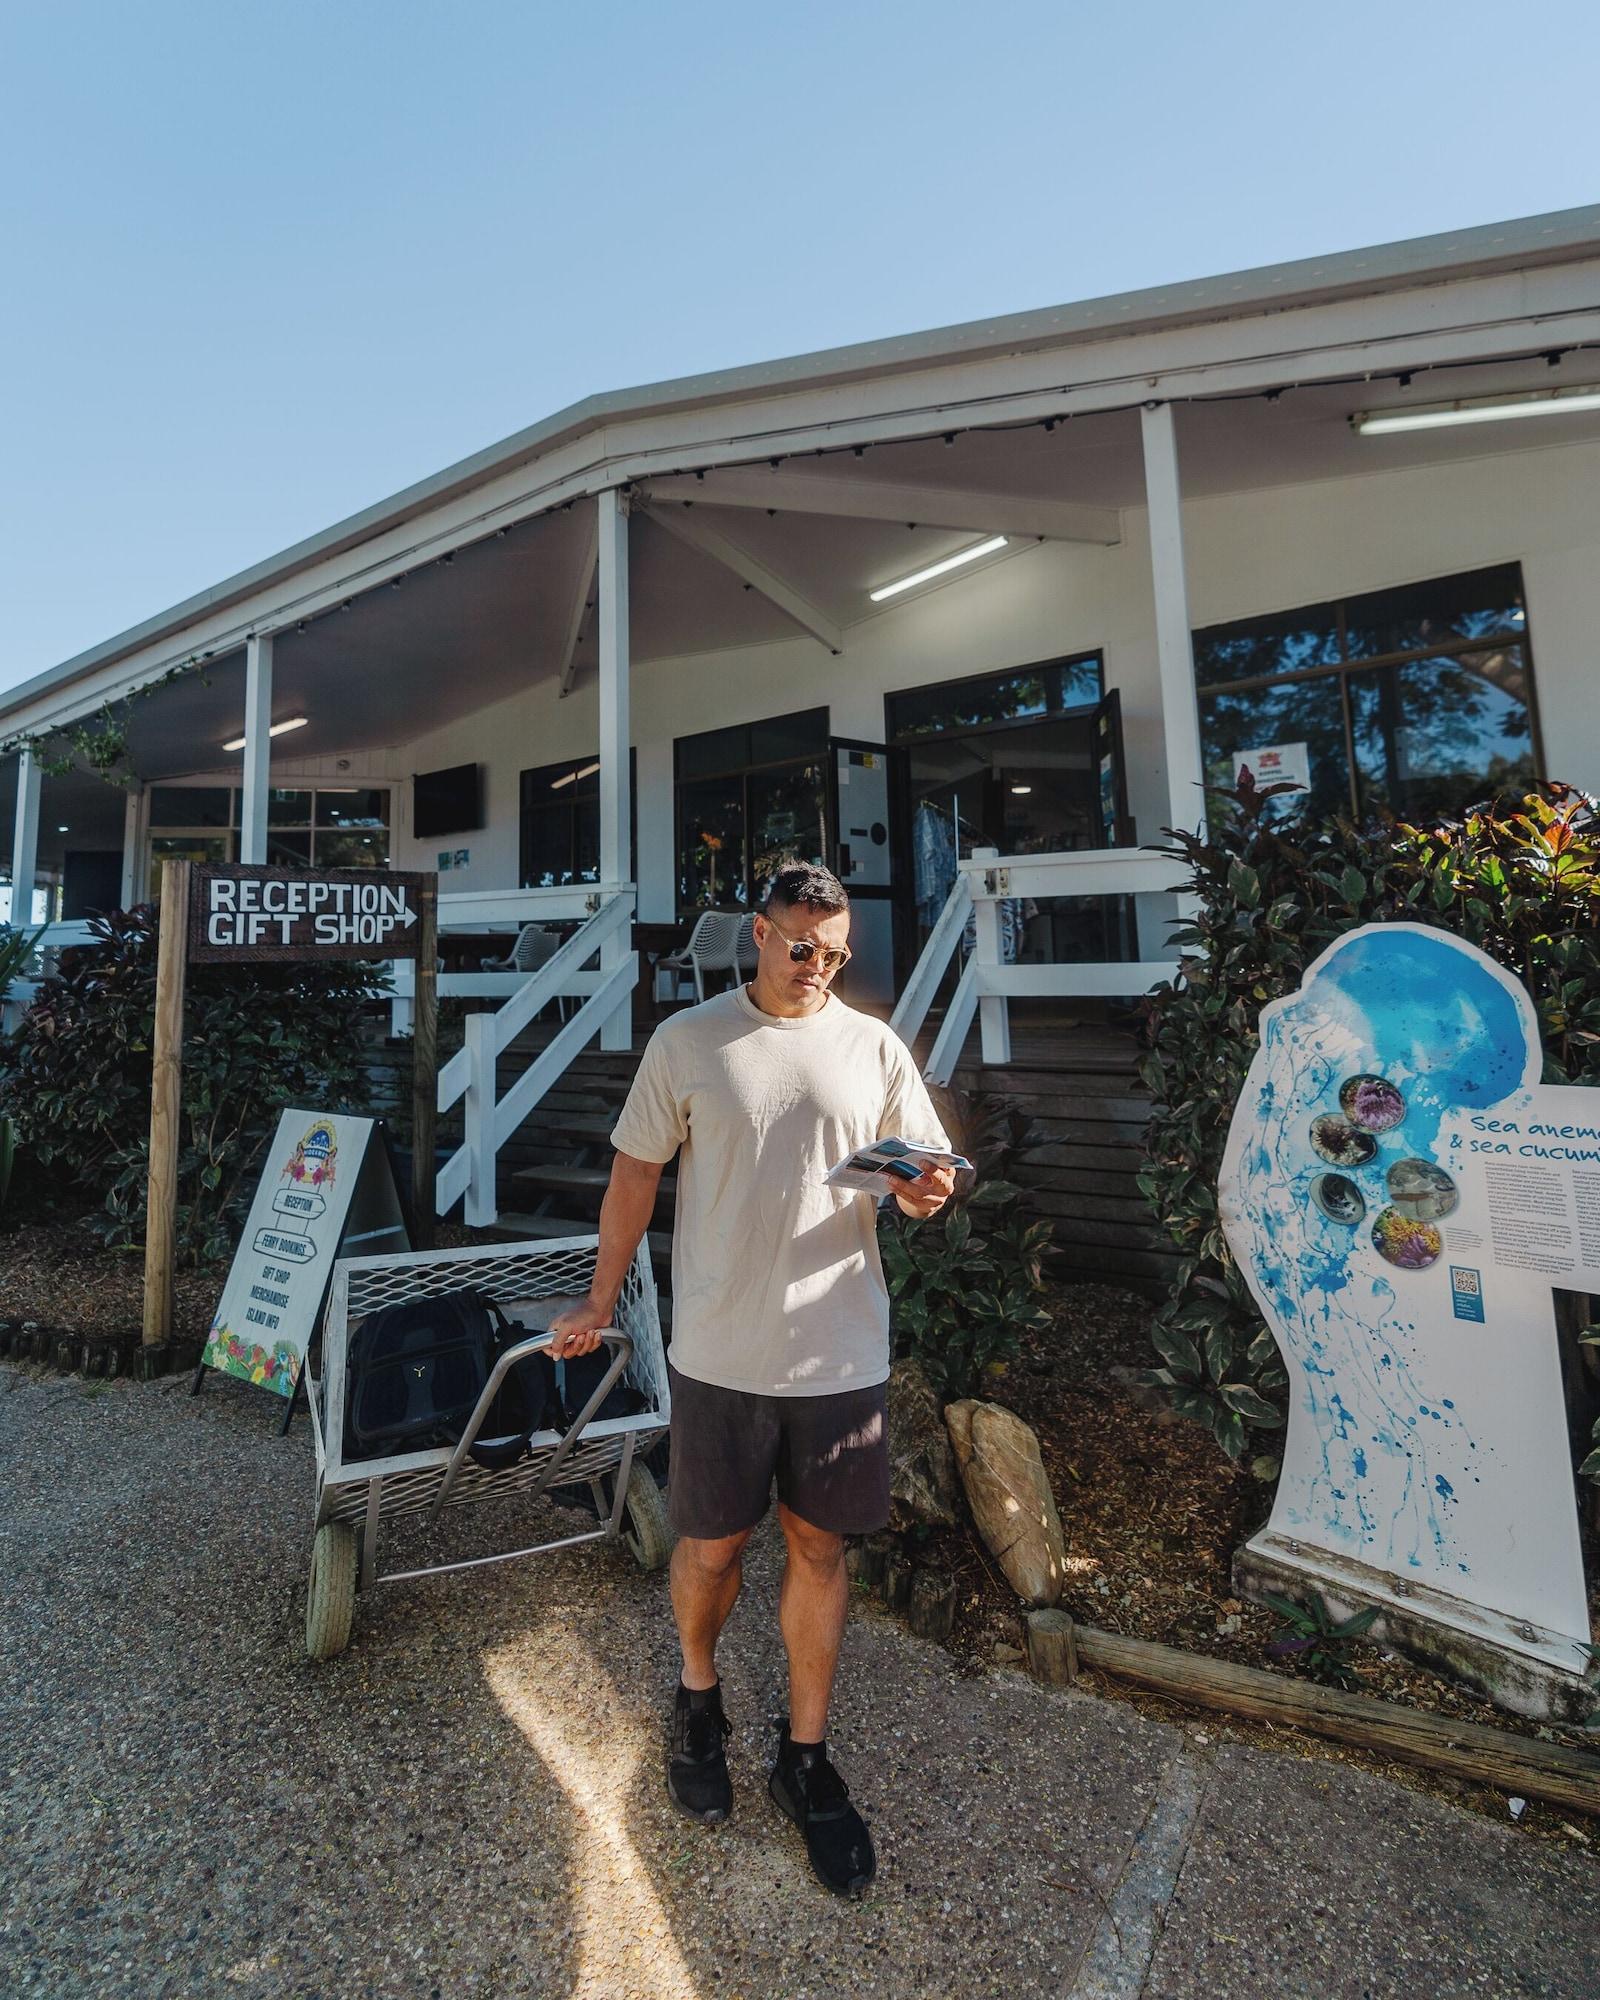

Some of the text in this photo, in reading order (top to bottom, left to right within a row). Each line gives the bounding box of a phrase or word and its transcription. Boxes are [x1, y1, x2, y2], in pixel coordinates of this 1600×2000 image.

[210, 879, 406, 914] RECEPTION
[208, 912, 395, 945] GIFT SHOP
[1471, 1116, 1600, 1140] Sea anem
[1450, 1134, 1600, 1162] & sea cucum
[284, 1195, 313, 1212] RECEPTION
[262, 1234, 306, 1256] FERRY BOOKINGS
[262, 1266, 291, 1285] GIFT SHOP
[250, 1285, 290, 1309] MERCHANDISE
[246, 1306, 280, 1330] ISLAND INFO
